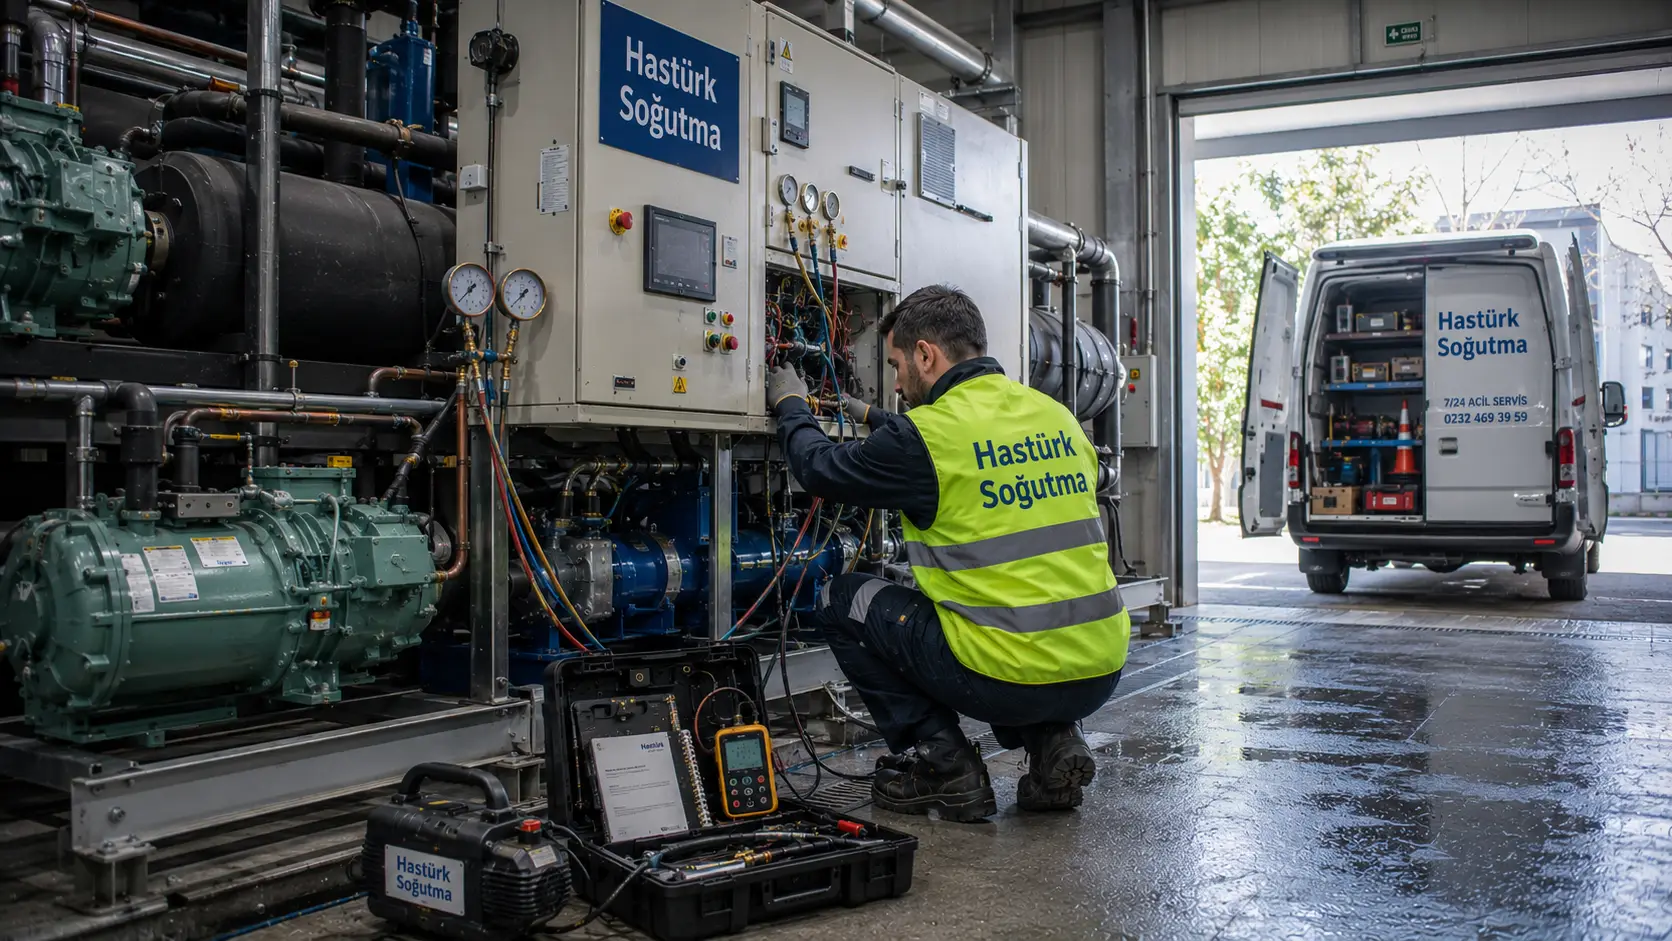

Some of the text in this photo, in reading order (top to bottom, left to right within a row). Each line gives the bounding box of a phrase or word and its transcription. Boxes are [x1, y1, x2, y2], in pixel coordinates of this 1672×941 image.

[626, 35, 717, 104] Hastürk
[619, 84, 722, 151] Soğutma
[1438, 308, 1519, 330] Hastürk
[1437, 336, 1527, 360] Soğutma
[1443, 394, 1528, 408] 7/24 ACİL SERVİS
[1444, 411, 1528, 425] 0232 469 39 59
[973, 430, 1077, 470] Hastürk
[980, 472, 1089, 510] Soğutma
[397, 856, 450, 882] Hastürk
[397, 875, 452, 901] Soğutma
